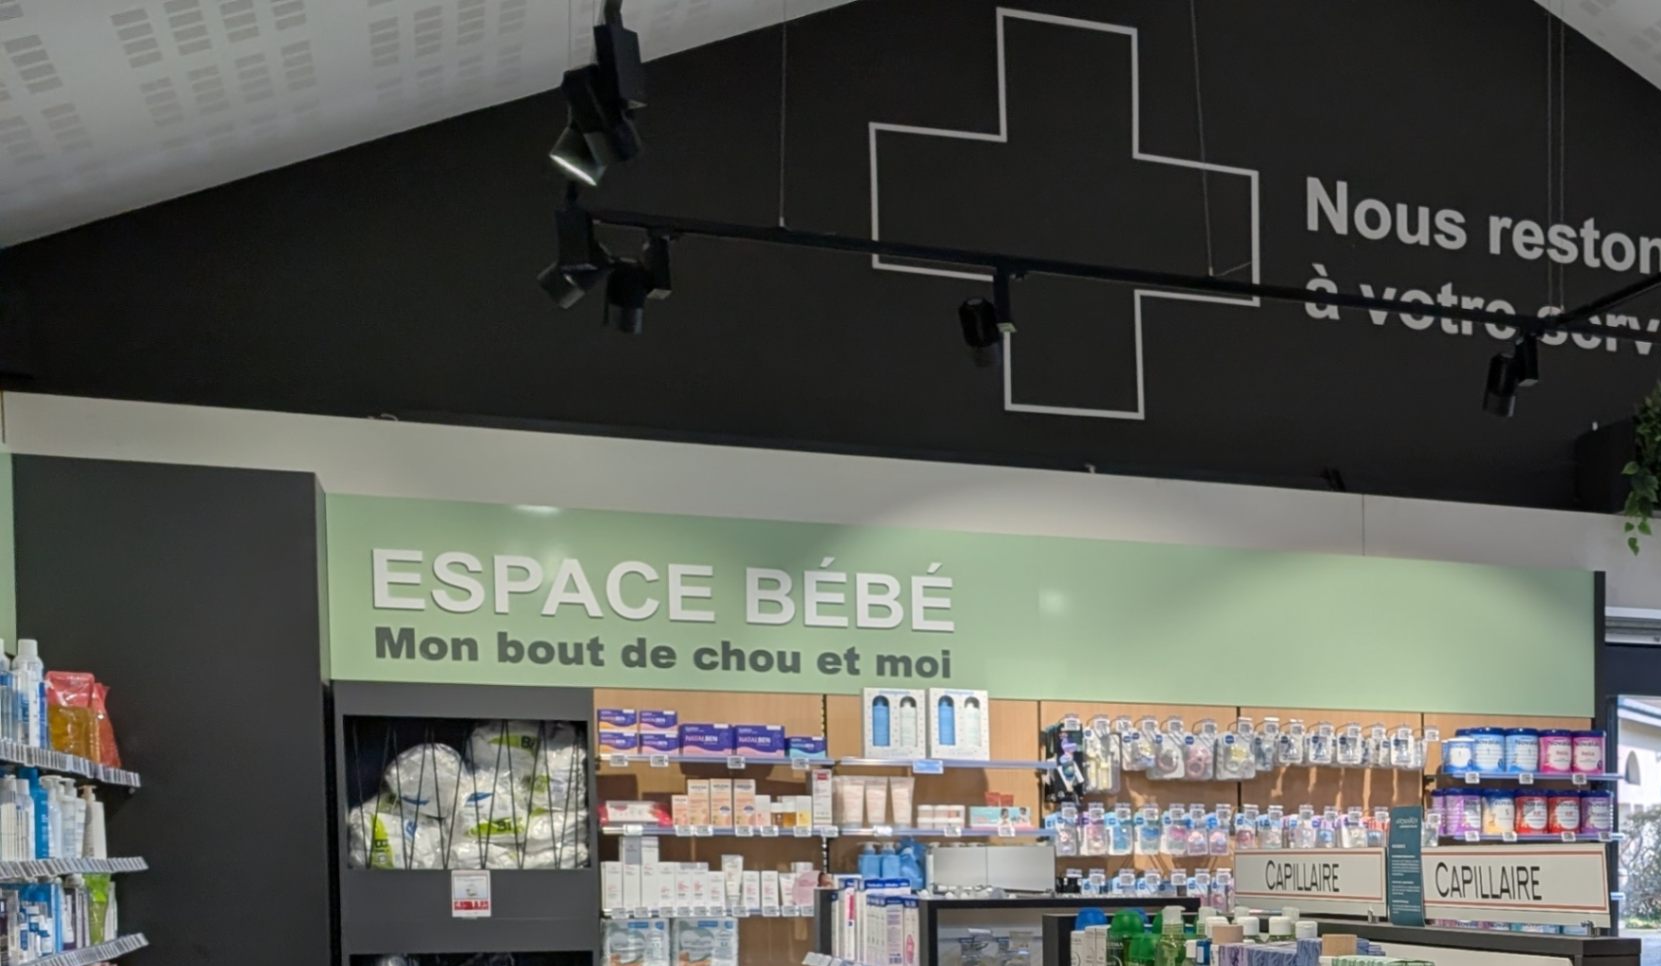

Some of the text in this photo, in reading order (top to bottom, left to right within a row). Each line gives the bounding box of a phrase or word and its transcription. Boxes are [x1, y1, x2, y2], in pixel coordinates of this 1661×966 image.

[1306, 175, 1468, 251] Nous
[1304, 262, 1341, 322] à
[1359, 281, 1517, 341] votre
[371, 547, 956, 633] ESPACE BÉBÉ
[375, 627, 952, 680] Mon bout de chou et moi
[1265, 859, 1340, 892] CAPILLAIRE
[1435, 862, 1542, 900] CAPILLAIRE
